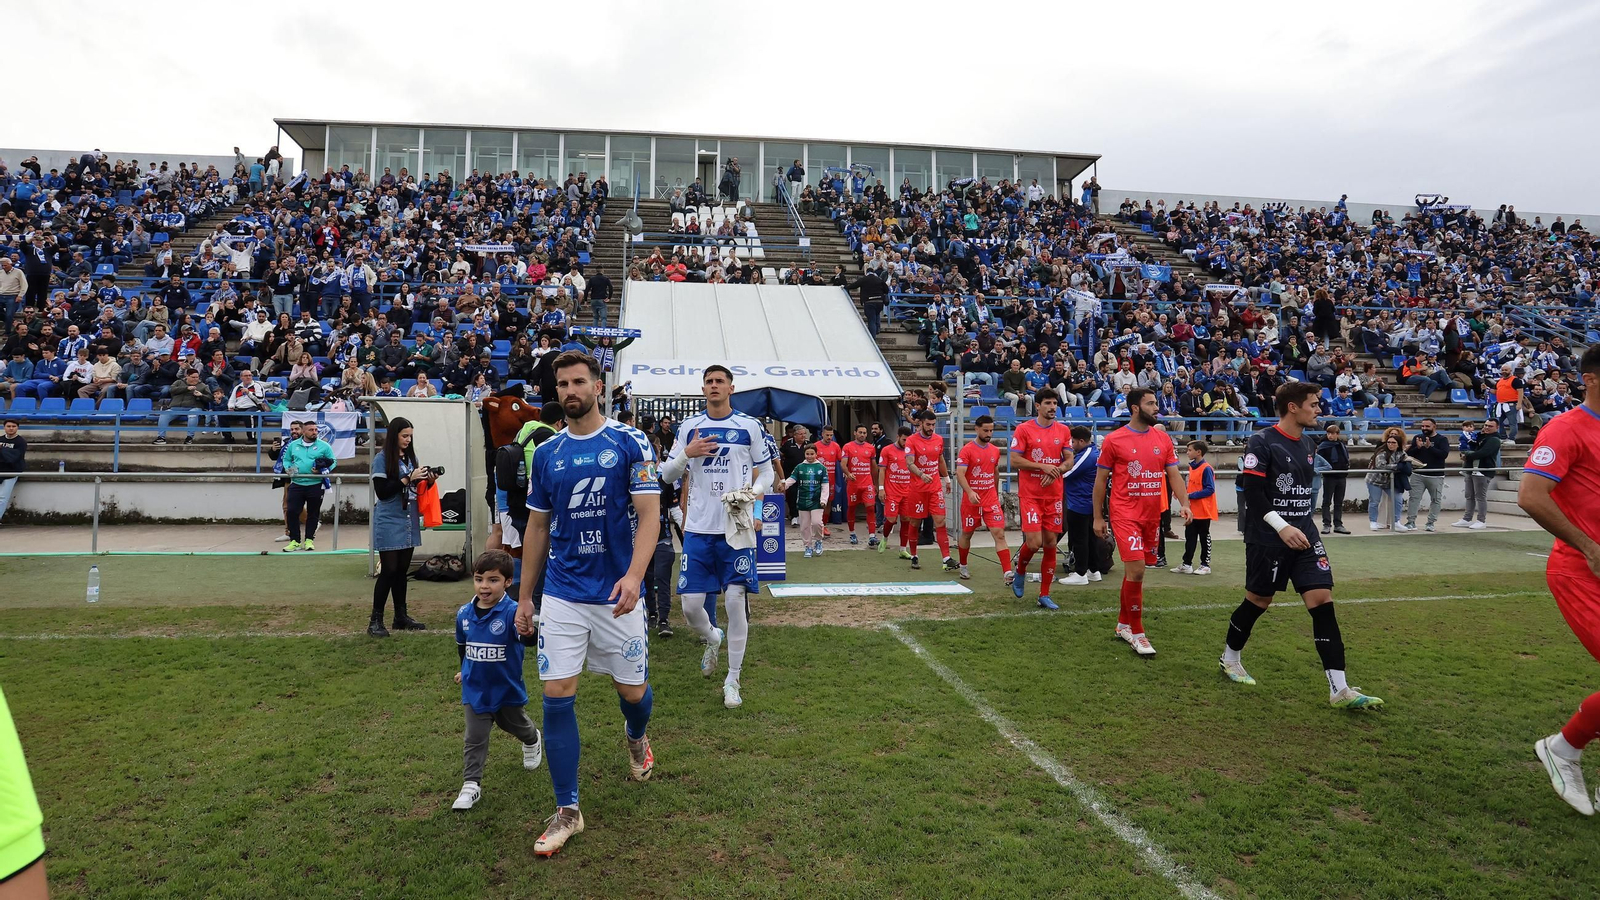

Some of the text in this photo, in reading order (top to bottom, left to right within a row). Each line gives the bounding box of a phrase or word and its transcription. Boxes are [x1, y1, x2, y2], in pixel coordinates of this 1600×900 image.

[590, 327, 624, 337] XEREZ
[631, 364, 880, 378] Pedr S. Garrido
[714, 457, 730, 466] Air
[1291, 485, 1312, 495] riber
[584, 492, 607, 507] Air
[890, 503, 896, 512] 3
[915, 503, 924, 513] 24
[570, 509, 607, 519] oneair.es
[1027, 512, 1038, 524] 14
[965, 517, 974, 527] 19
[580, 530, 602, 545] L3G
[1272, 566, 1278, 583] 1
